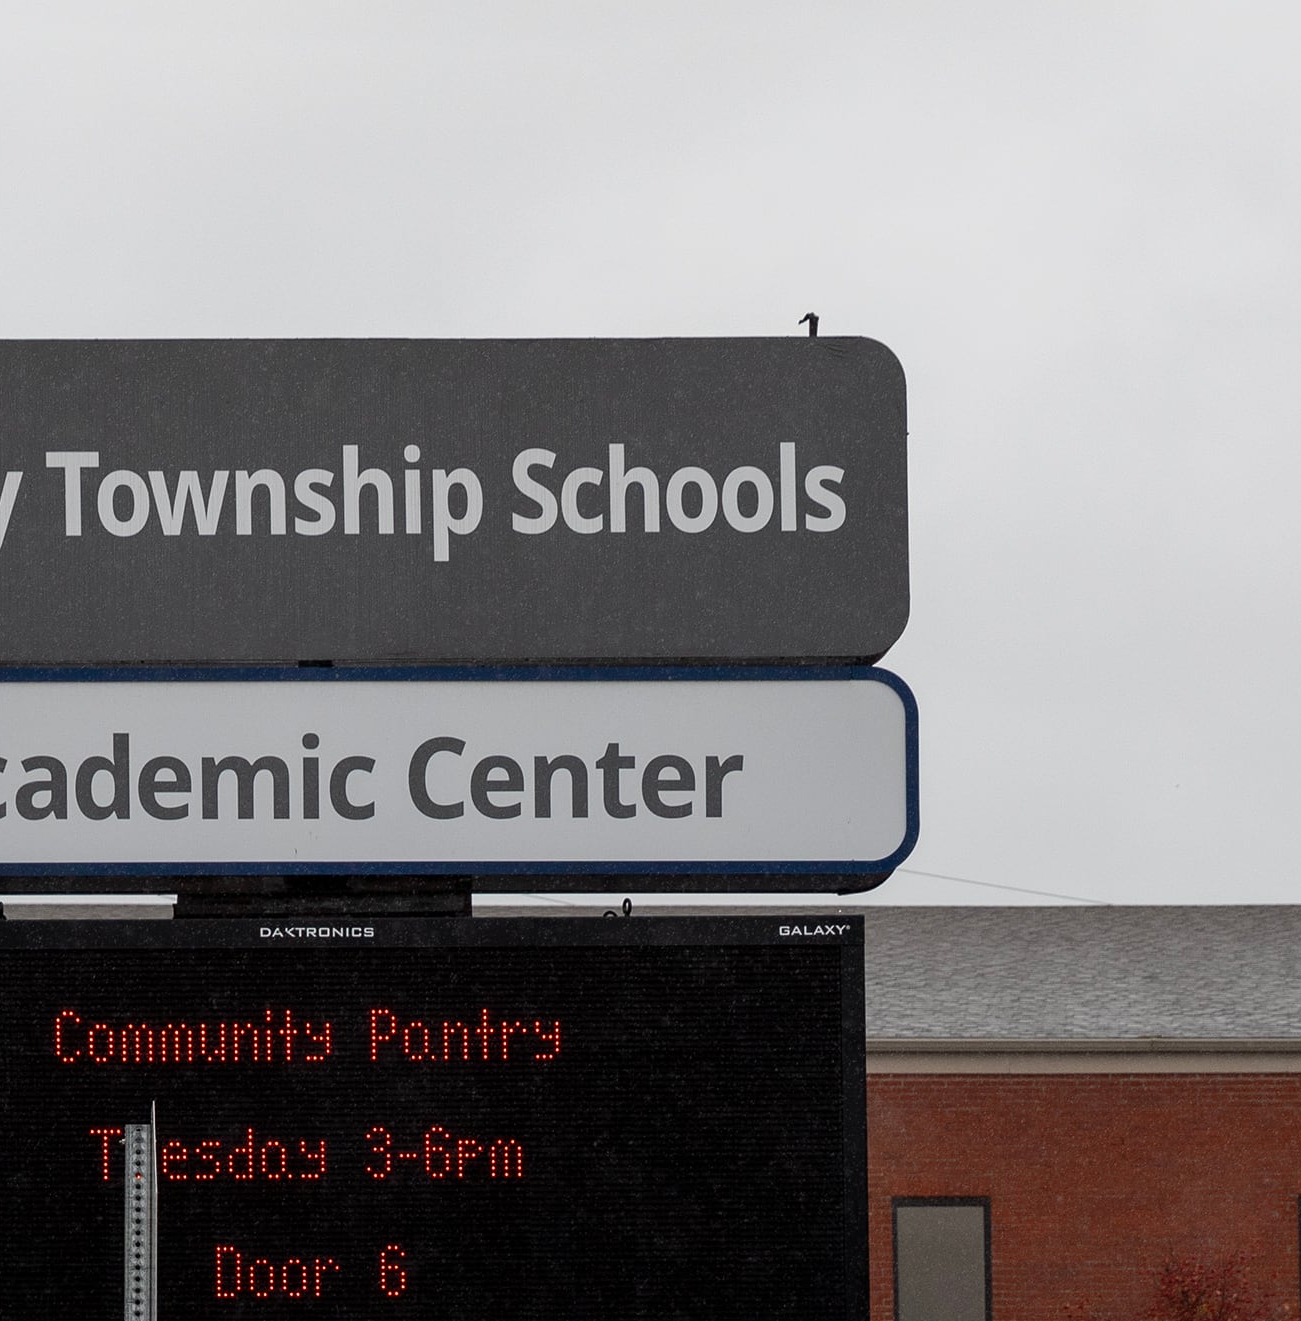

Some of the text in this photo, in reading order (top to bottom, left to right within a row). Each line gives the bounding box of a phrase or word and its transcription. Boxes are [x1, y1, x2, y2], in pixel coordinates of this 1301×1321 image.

[45, 444, 484, 562] Township
[512, 441, 847, 535] Schools
[408, 736, 744, 820] Center
[259, 926, 375, 938] DAKTRONICS
[54, 1007, 561, 1064] Community Pantry
[89, 1125, 523, 1182] Tesday 3-6pm
[215, 1244, 407, 1299] Door 6
